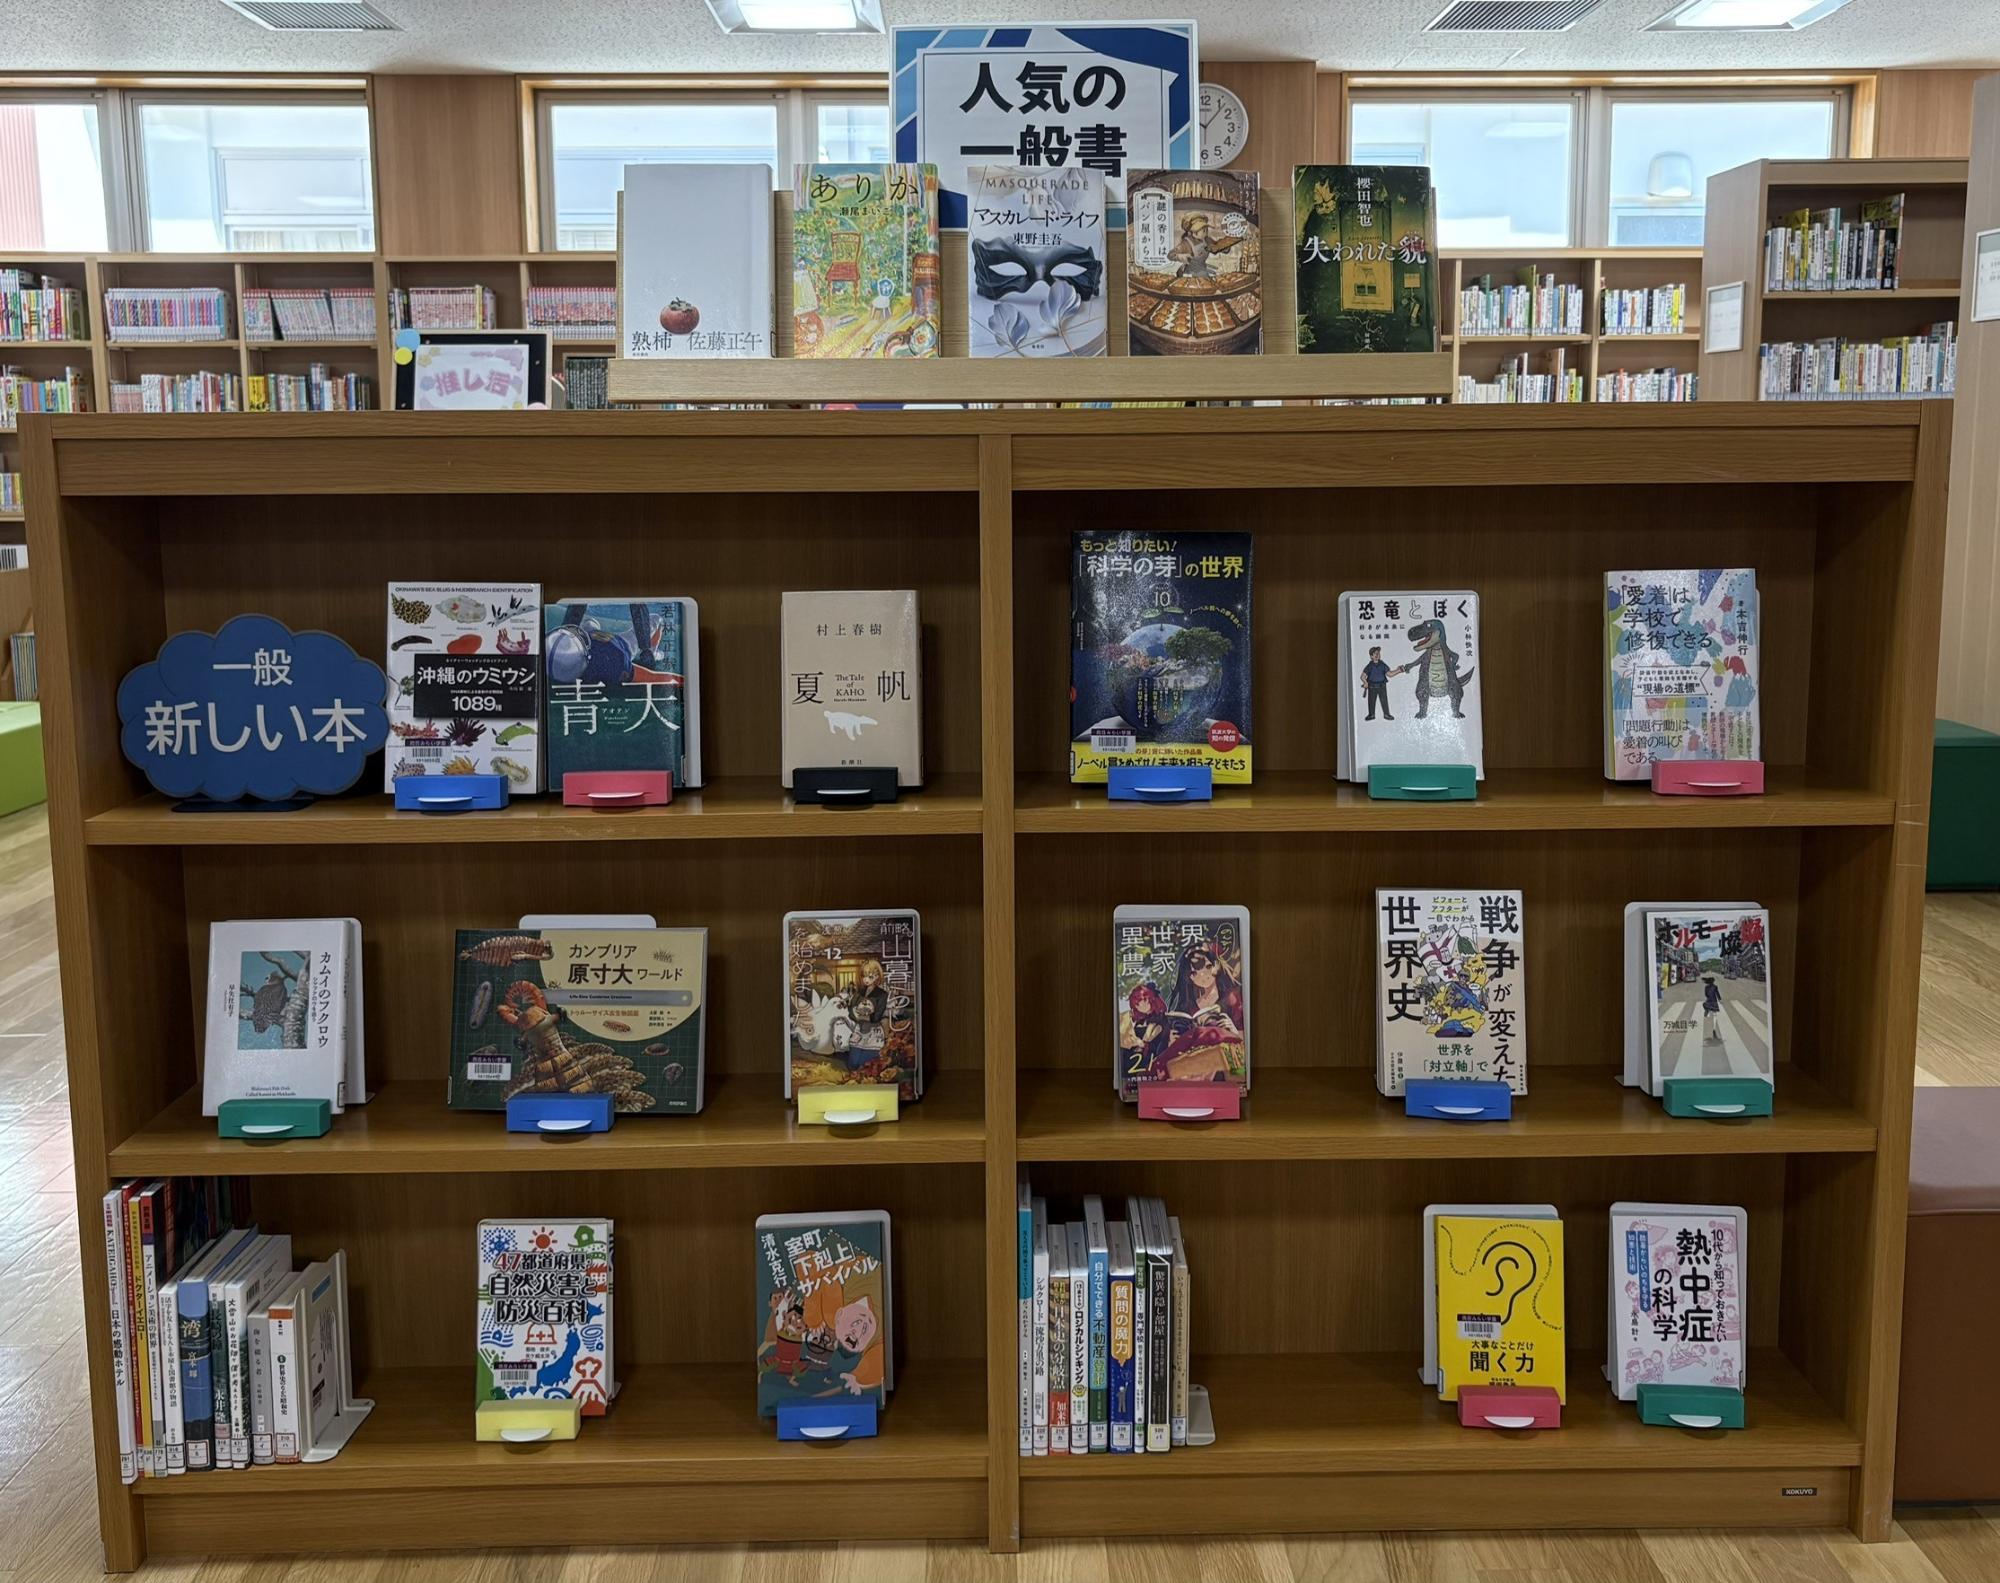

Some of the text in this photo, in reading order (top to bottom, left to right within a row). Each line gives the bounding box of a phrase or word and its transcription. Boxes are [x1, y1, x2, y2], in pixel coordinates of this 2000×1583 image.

[960, 62, 1126, 114] 人気の
[1200, 95, 1211, 105] 12
[1224, 109, 1232, 119] 2
[1227, 122, 1235, 133] 3
[960, 123, 1128, 178] 一般書
[1214, 146, 1222, 156] 5
[1224, 136, 1231, 147] 4
[1201, 149, 1209, 160] 6
[811, 174, 919, 203] ありか
[985, 178, 1089, 191] MASQUERADE
[1022, 194, 1053, 205] LIFE
[1355, 177, 1374, 228] 櫻田智也
[973, 208, 1100, 228] マスカレード・ライフ
[1140, 202, 1151, 257] パン屋から
[1156, 202, 1167, 256] 謎の香りは
[1012, 231, 1062, 246] 東野圭吾
[1303, 235, 1428, 265] 失われた貌
[632, 331, 763, 351] 熟柿 佐藤正午
[434, 367, 513, 397] 推し活
[1080, 539, 1178, 553] もっと知りたい！
[1079, 555, 1244, 578] 「科学の芽」の世界
[1155, 591, 1170, 606] 10
[1621, 584, 1692, 606] 「愛着」は
[1358, 599, 1468, 621] 恐竜とぼく
[1622, 607, 1685, 629] 学校で
[816, 623, 882, 637] 村上春樹
[1624, 631, 1713, 651] 修復できる
[213, 648, 294, 687] 一般
[417, 666, 536, 685] 沖縄のウミウシ
[550, 678, 681, 737] 青天
[144, 698, 368, 756] 新しい本
[1622, 719, 1690, 733] 「問題行動」は
[1623, 734, 1683, 750] 愛着の叫び
[880, 921, 914, 938] 前略。
[1427, 914, 1475, 923] 一目でわかる
[1120, 923, 1205, 951] 異世界
[569, 943, 638, 960] カンブリア
[824, 947, 842, 960] 12
[1121, 949, 1176, 977] 農家
[1381, 896, 1423, 1022] 世界史
[790, 927, 815, 1033] を始めました。
[881, 934, 913, 1032] 山暮らし
[318, 952, 331, 1048] カムイのフクロウ
[1479, 895, 1520, 1092] 戦争が変えた
[1663, 1019, 1698, 1030] 万城目学
[1437, 1043, 1474, 1056] 世界を
[1423, 1059, 1489, 1073] 「対立軸」で
[784, 1228, 823, 1259] 室町
[761, 1232, 788, 1288] 清水克行
[789, 1241, 857, 1278] 「下剋上」
[489, 1272, 598, 1298] 自然災害と
[797, 1255, 882, 1298] サバイバル
[1676, 1228, 1715, 1343] 熱中症
[1711, 1229, 1727, 1343] 10代から知っておきたい
[135, 1275, 145, 1341] ドクターイエロー
[496, 1299, 588, 1324] 防災百科
[1036, 1277, 1047, 1322] シルクロード
[1652, 1268, 1678, 1342] の科学
[1114, 1284, 1130, 1355] 質問の魔力
[111, 1309, 125, 1387] 日本の感動ホテル
[1074, 1310, 1084, 1384] ロジカルシンキング
[1472, 1340, 1534, 1351] 大事なことだけ
[1470, 1351, 1534, 1373] 聞く力
